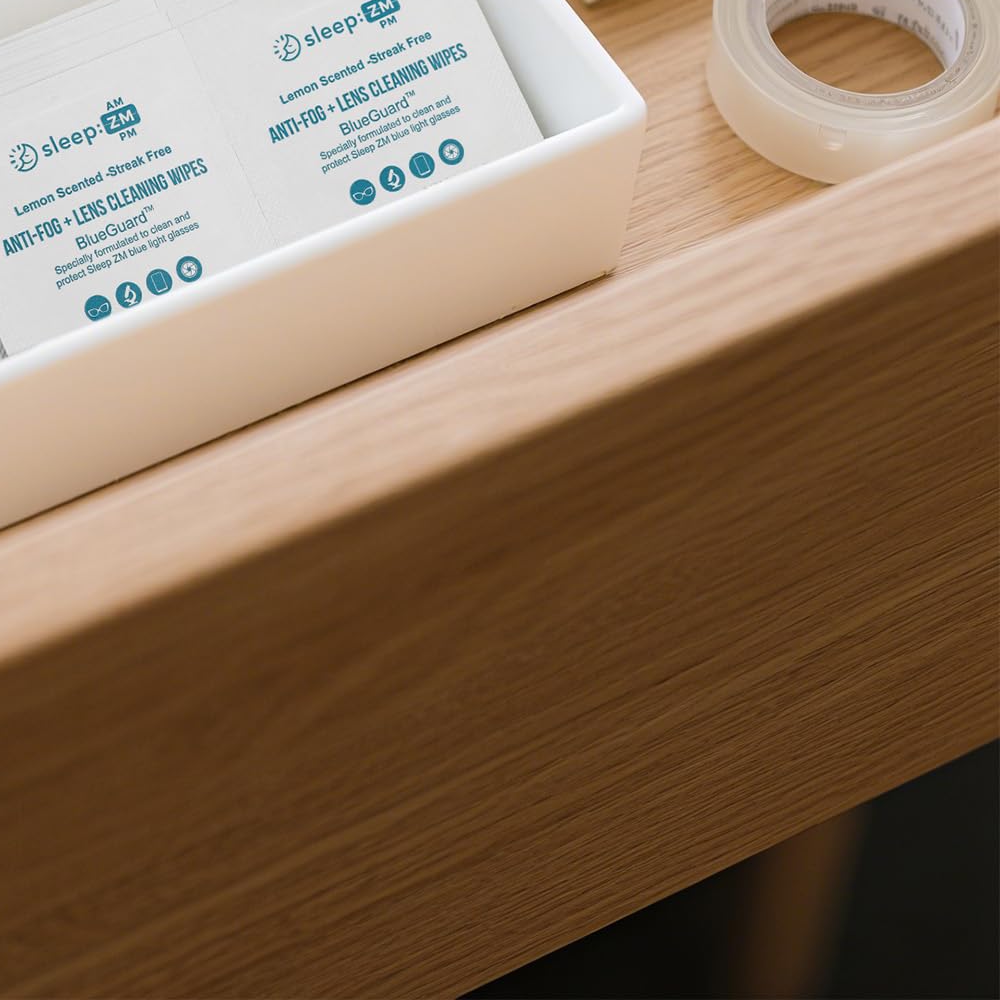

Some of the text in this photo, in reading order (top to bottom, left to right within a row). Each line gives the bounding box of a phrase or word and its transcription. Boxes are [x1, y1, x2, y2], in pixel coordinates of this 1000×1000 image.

[379, 15, 398, 29] PM
[268, 105, 327, 144] ANTI-FOG
[335, 86, 370, 113] LENS
[368, 59, 429, 98] CLEANING
[426, 43, 468, 71] WIPES
[279, 82, 319, 105] Lemon
[319, 59, 365, 87] Scented
[406, 32, 432, 48] Free
[106, 97, 124, 111] AM
[106, 109, 135, 129] ZM
[119, 128, 137, 141] PM
[320, 95, 452, 160] Specially formulated to clean and
[321, 106, 461, 175] protect Sleep ZM blue light glasses
[2, 218, 63, 257] ANTI-FOG
[72, 199, 108, 226] LENS
[106, 173, 169, 212] CLEANING
[166, 158, 208, 186] WIPES
[14, 194, 56, 217] Lemon
[56, 171, 104, 199] Scented
[145, 146, 172, 162] Free
[55, 211, 191, 275] Specially formulated to clean and
[56, 222, 200, 290] protect Sleep ZM blue light glasses
